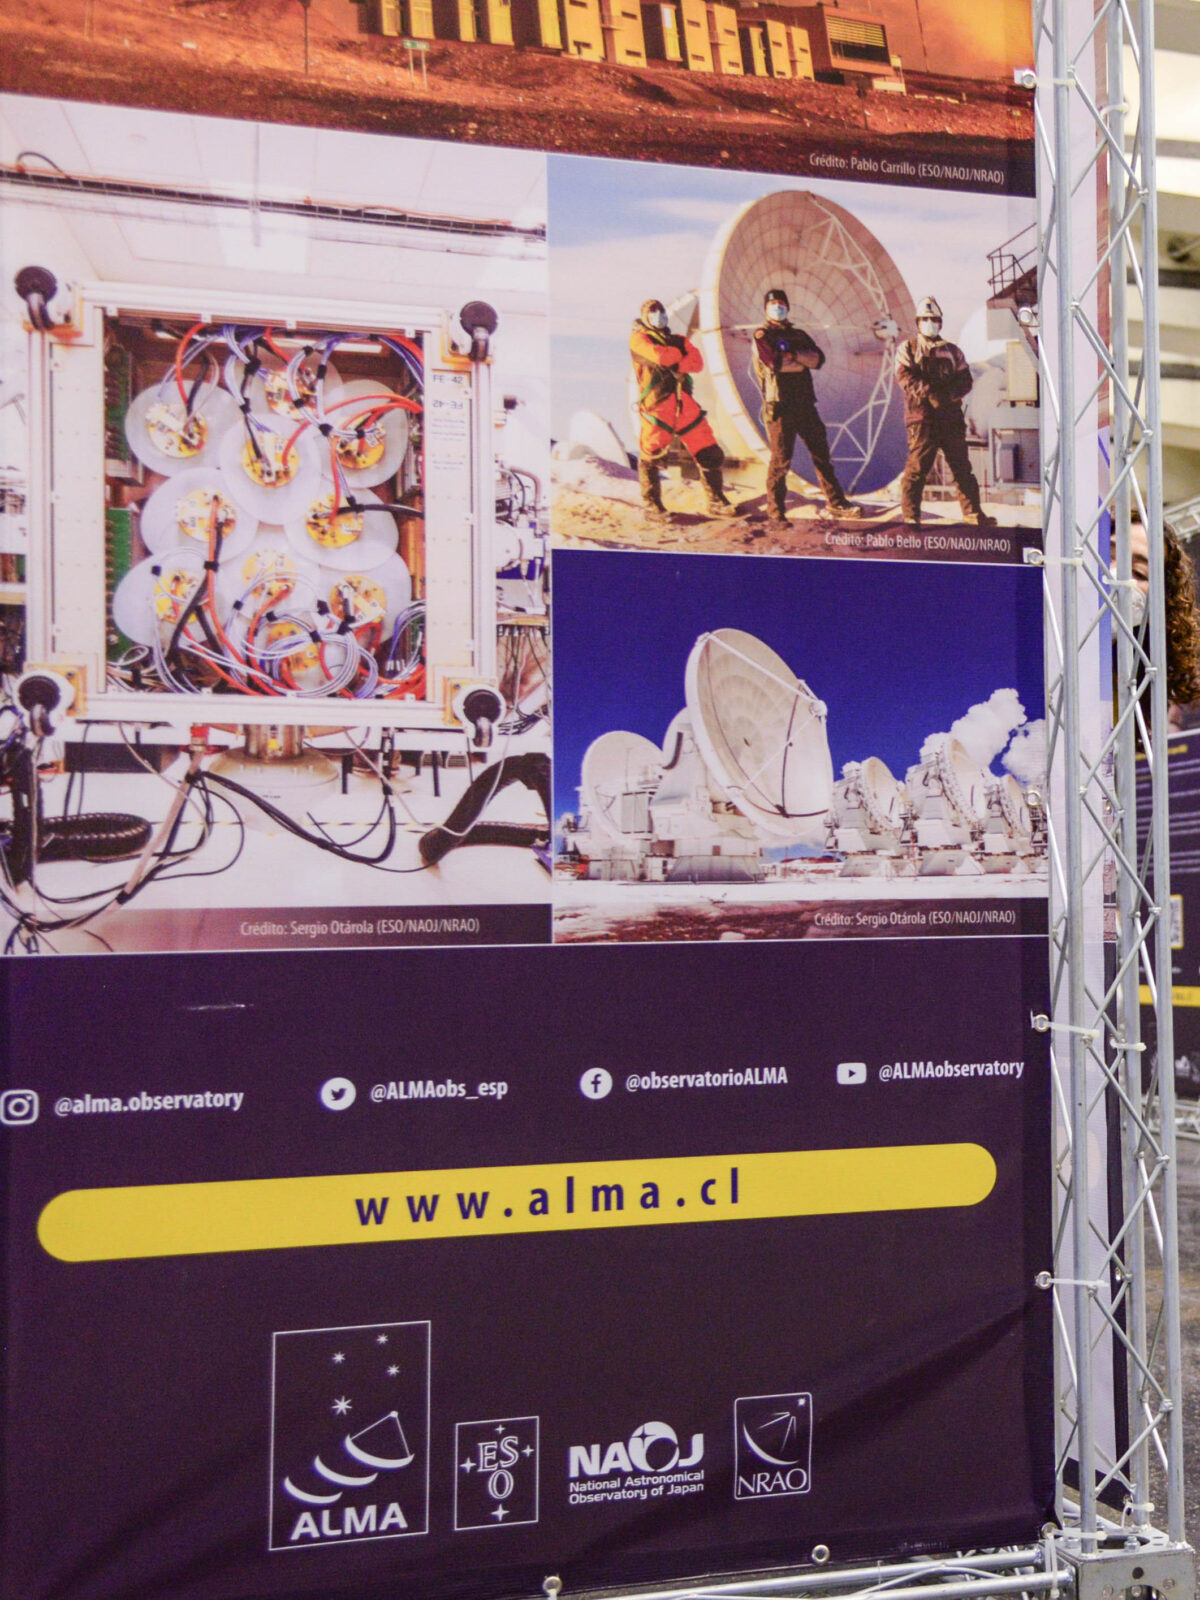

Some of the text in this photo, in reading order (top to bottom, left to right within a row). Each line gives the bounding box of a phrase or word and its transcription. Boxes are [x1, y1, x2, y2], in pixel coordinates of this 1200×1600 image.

[809, 152, 1005, 185] Crédito: Pablo Carrillo (ESO/NAOJ/NRAO)
[824, 531, 1011, 554] Crédito: Pablo Bello (ESO/NAOJ/NRAO)
[240, 917, 480, 939] Crédito: Sergio Otárola (ESO/NAOJ/NRAO)
[814, 910, 1016, 929] Crédito: Sergio Otárola (ESO/NAOJ/NRAO)
[54, 1060, 1025, 1117] @alma.observatory @ALMAobs_esp @observatorioALMA @ALMAobservatory
[355, 1167, 739, 1227] www.alma.cl
[568, 1421, 704, 1478] NAOJ
[477, 1436, 519, 1499] ESO
[569, 1469, 705, 1493] National Astronomical
[737, 1468, 808, 1496] NRAO
[569, 1481, 704, 1505] Observatory of Japan
[290, 1502, 409, 1541] ALMA
